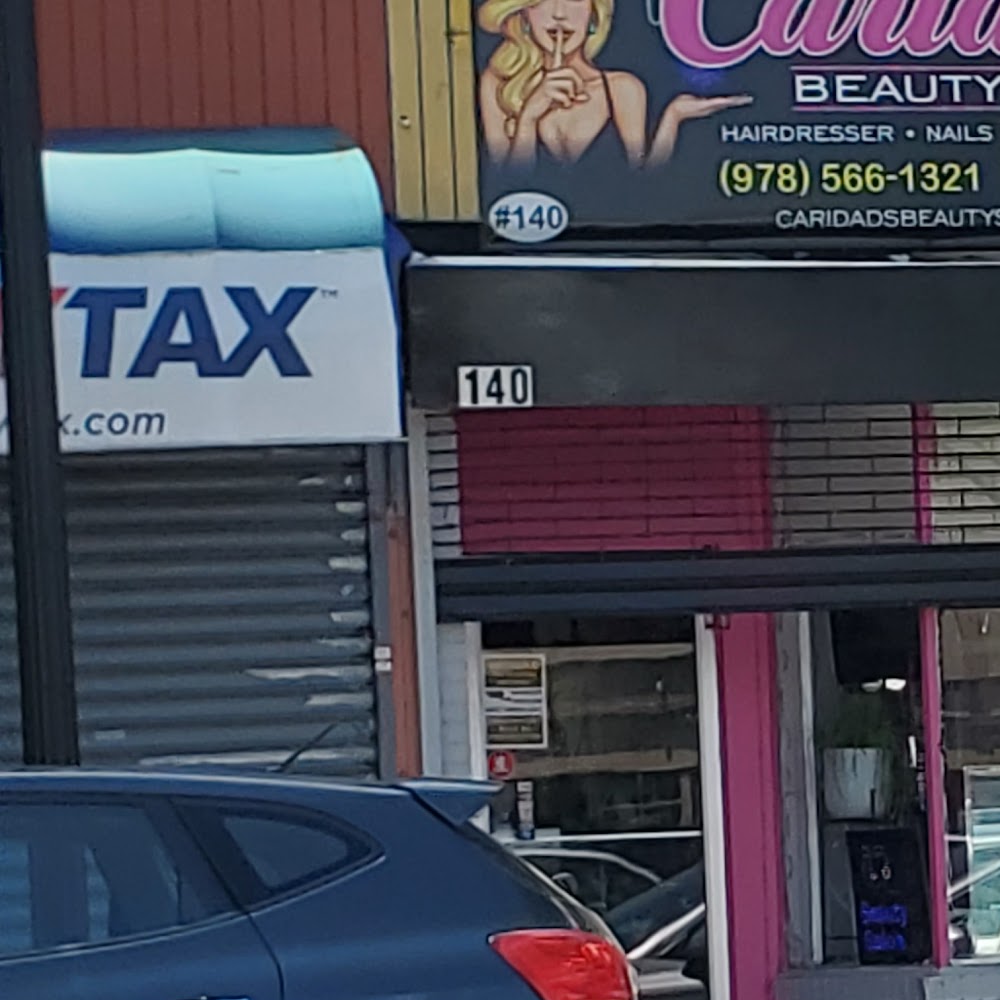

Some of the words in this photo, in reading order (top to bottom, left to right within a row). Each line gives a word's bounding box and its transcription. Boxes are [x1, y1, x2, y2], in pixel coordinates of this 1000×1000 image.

[720, 125, 895, 143] HAIRDRESSER
[926, 125, 993, 142] NAILS
[719, 159, 810, 198] (978)
[821, 162, 980, 194] 566-1321
[494, 205, 564, 233] #140
[63, 286, 318, 377] TAX
[464, 367, 529, 405] 140
